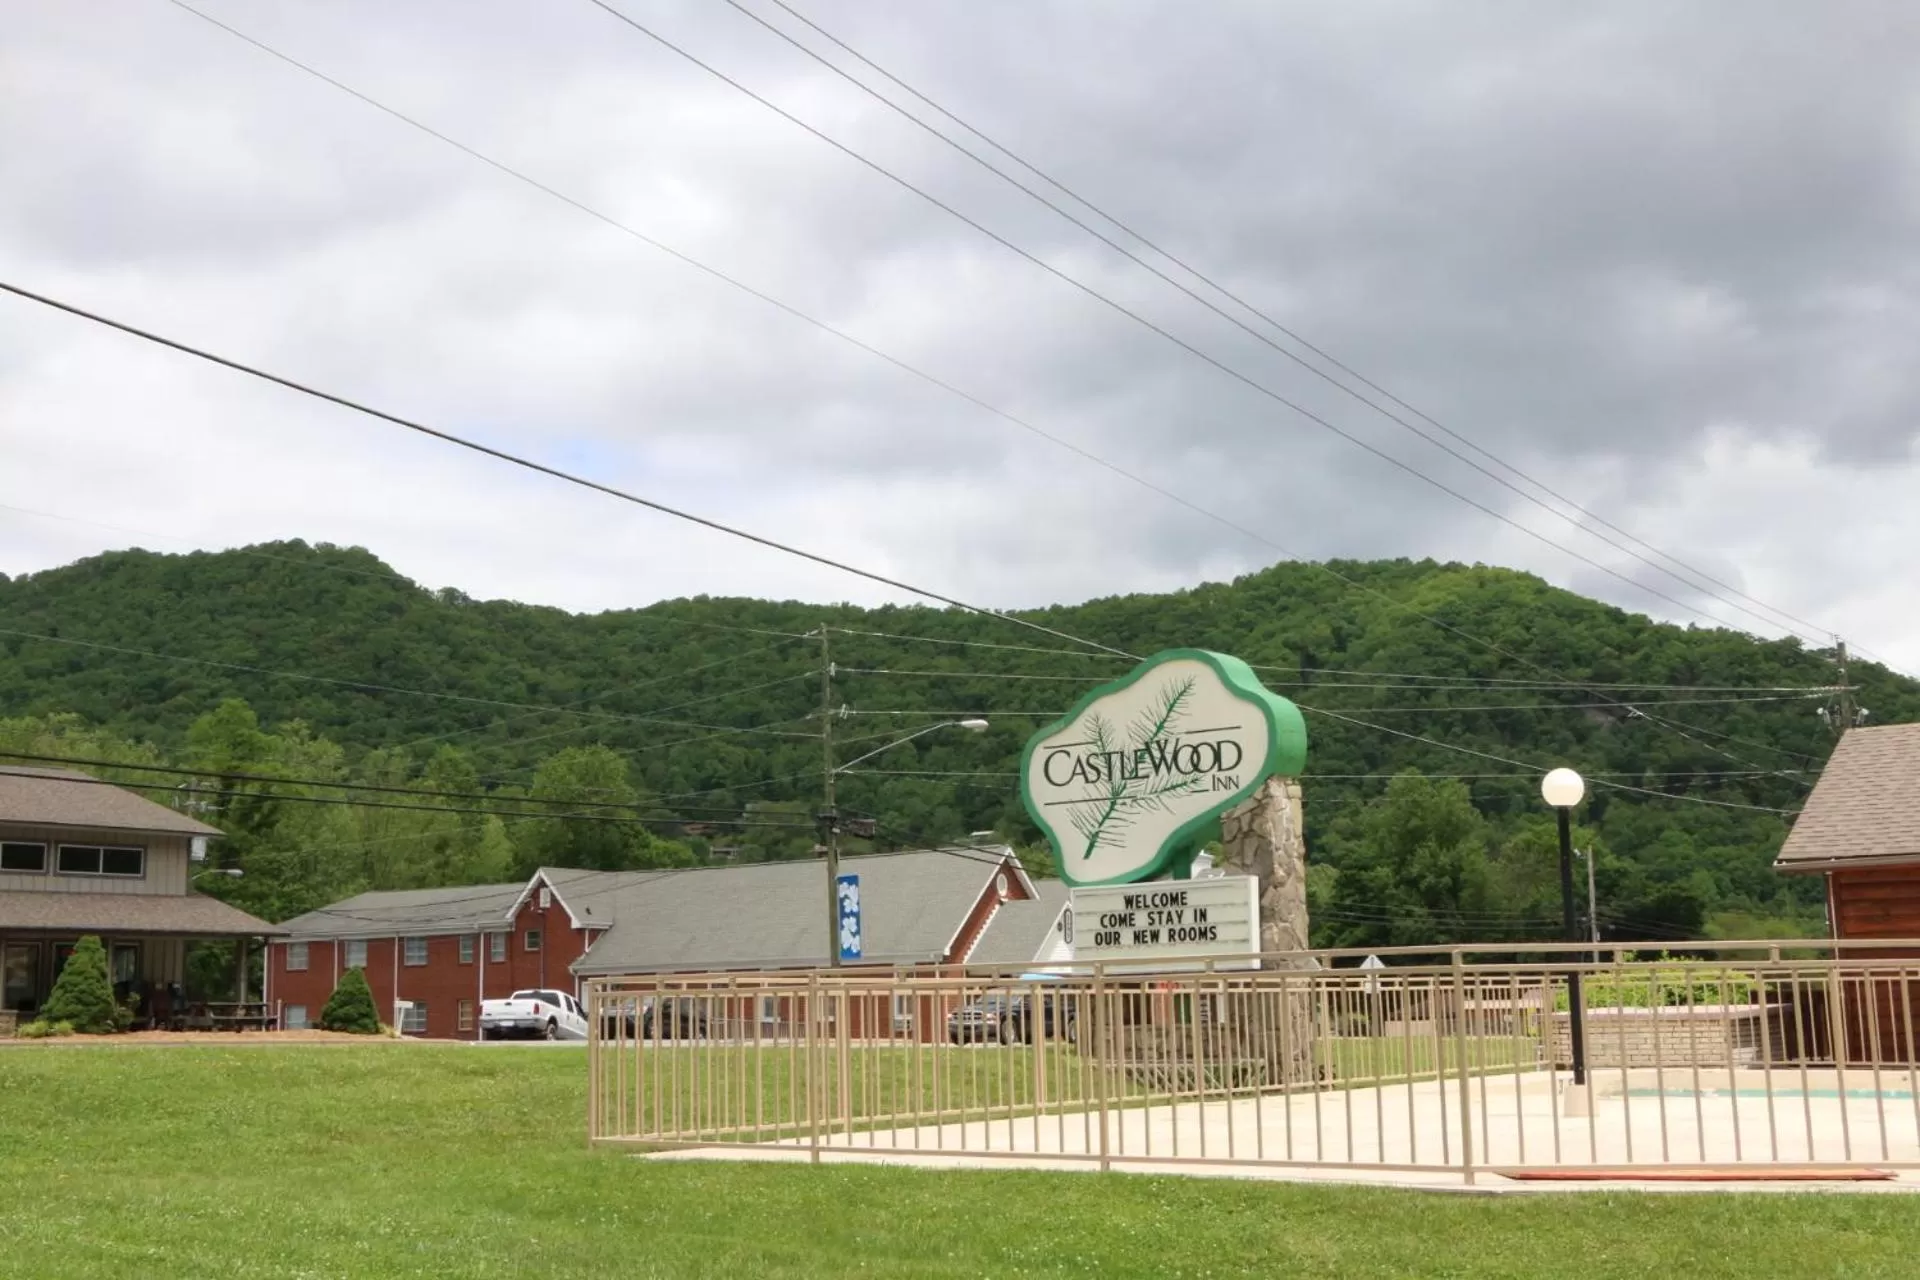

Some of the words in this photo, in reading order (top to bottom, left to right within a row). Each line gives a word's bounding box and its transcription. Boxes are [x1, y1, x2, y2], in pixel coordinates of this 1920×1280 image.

[1212, 774, 1240, 792] INN
[1123, 891, 1188, 909] WELCOME
[1100, 912, 1136, 928] COME
[1147, 909, 1184, 926] STAY
[1194, 908, 1207, 923] IN
[1094, 931, 1121, 946] OUR
[1133, 929, 1160, 945] NEW
[1168, 925, 1217, 942] ROOMS
